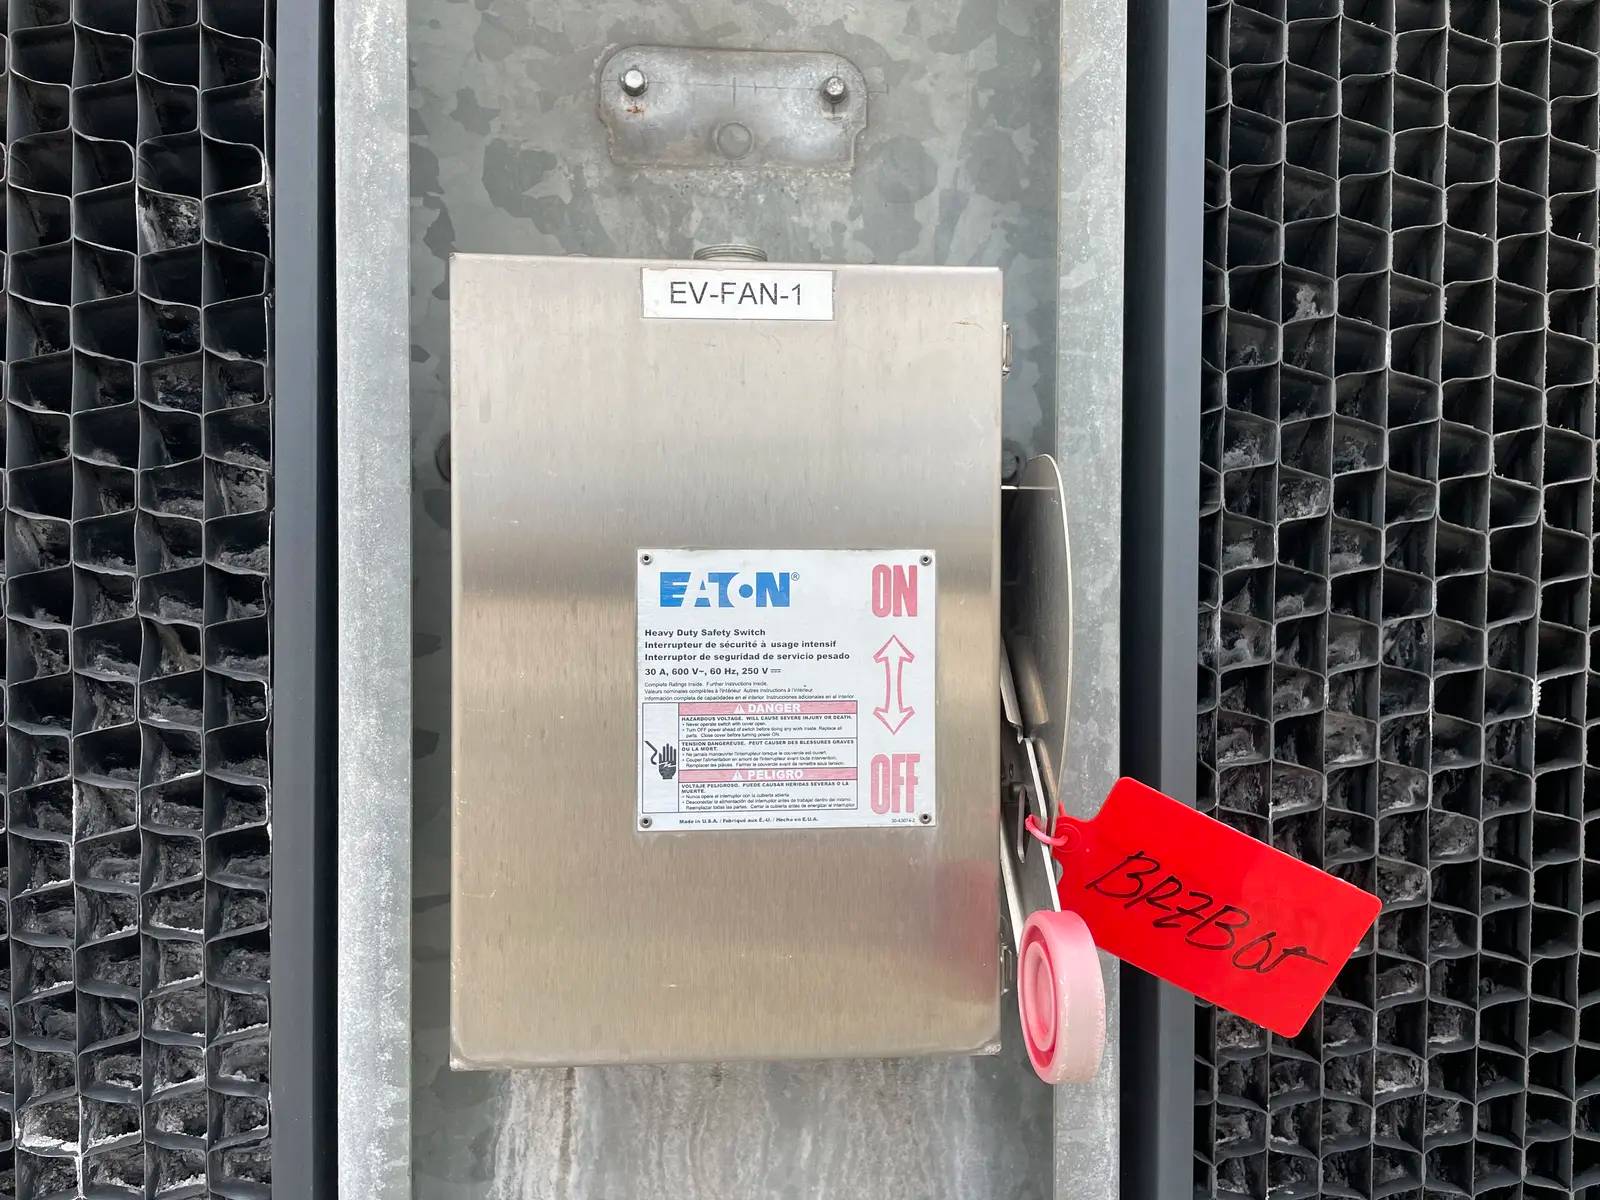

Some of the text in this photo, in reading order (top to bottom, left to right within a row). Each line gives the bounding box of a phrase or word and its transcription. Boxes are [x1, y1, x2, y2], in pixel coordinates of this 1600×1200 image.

[670, 281, 801, 306] EV-FAN-1
[872, 564, 918, 618] ON
[645, 629, 674, 637] Heavy
[676, 629, 698, 637] Duty
[701, 629, 731, 637] Safety
[645, 641, 703, 650] Interrupteur
[771, 640, 799, 649] usage
[645, 653, 697, 662] Interruptor
[714, 653, 760, 661] seguridad
[816, 652, 850, 661] pesado
[748, 703, 801, 712] DANGER
[748, 769, 804, 780] PELIGRO
[870, 753, 920, 814] OFF
